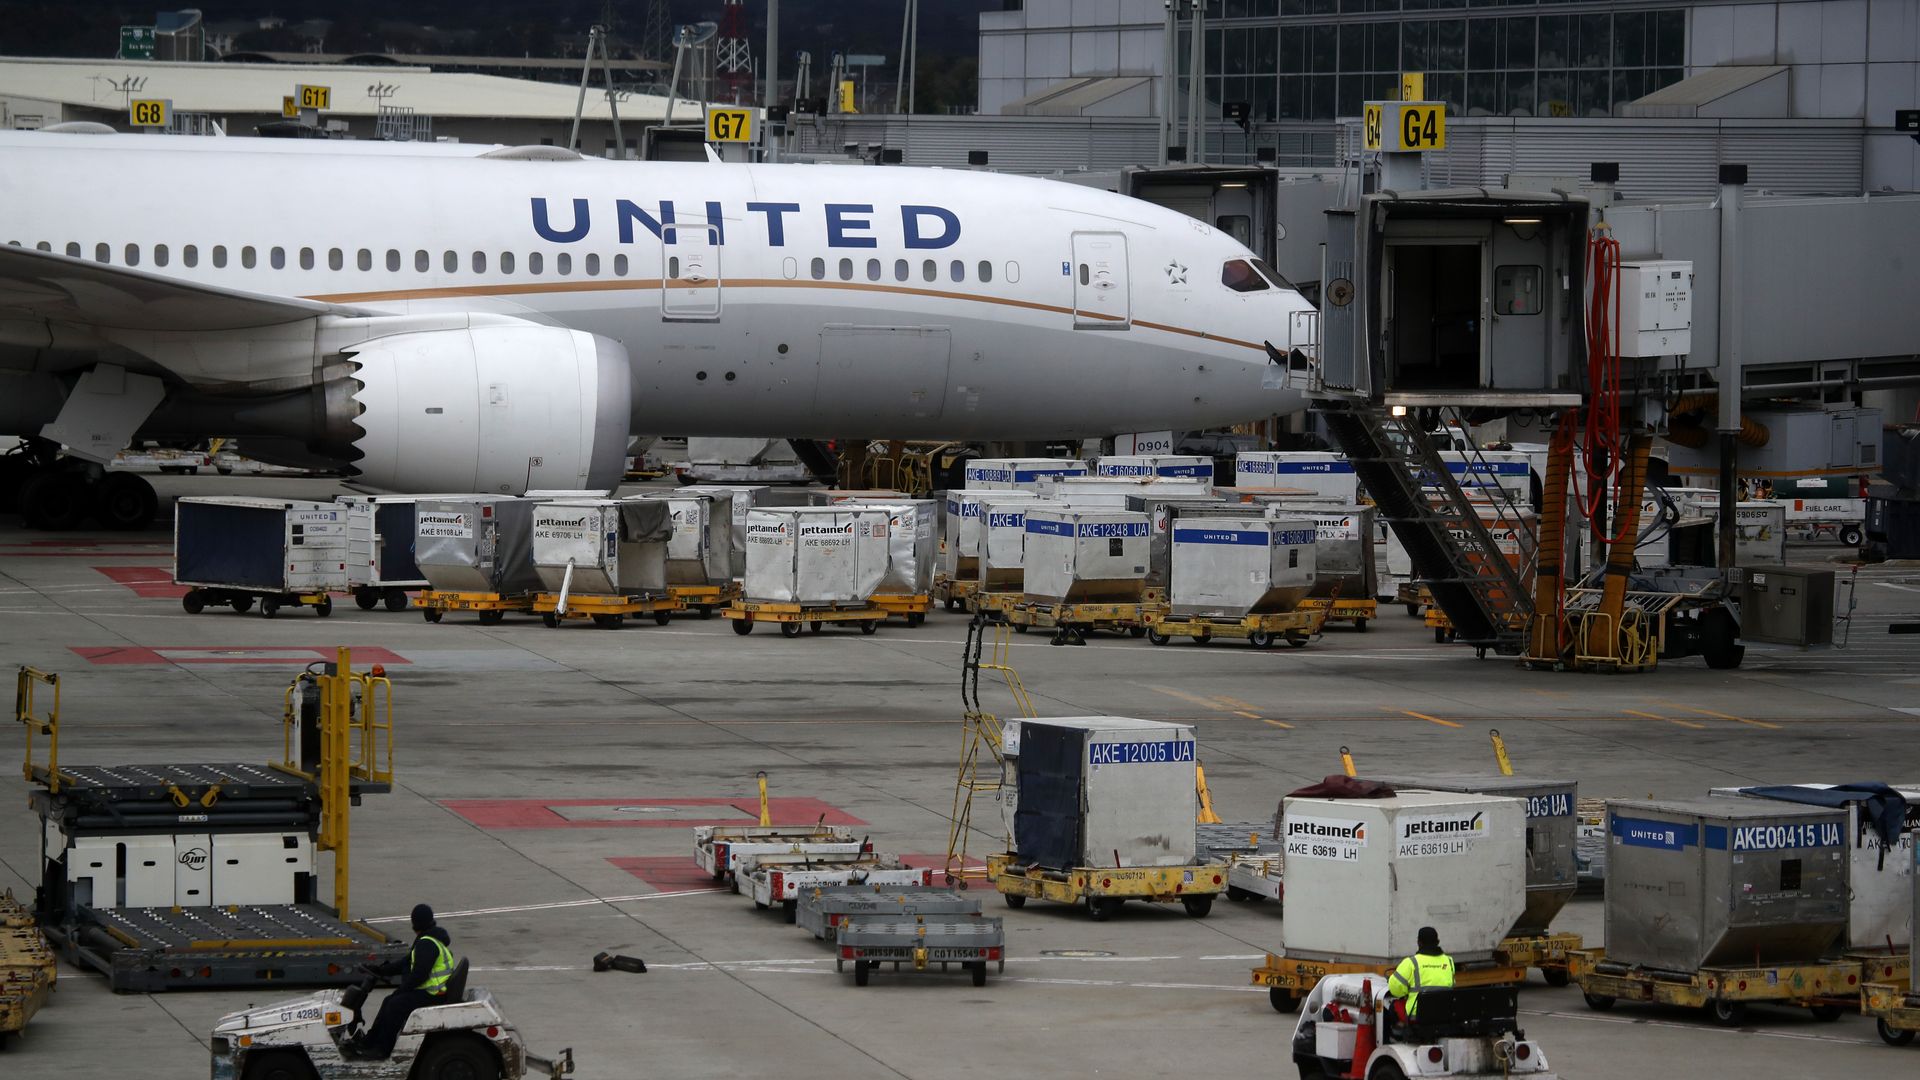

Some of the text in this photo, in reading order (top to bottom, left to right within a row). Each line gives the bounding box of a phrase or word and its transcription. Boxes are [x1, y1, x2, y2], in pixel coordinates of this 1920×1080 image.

[303, 88, 327, 106] G11
[136, 103, 160, 123] G8
[714, 112, 745, 139] G7
[1367, 109, 1381, 146] G4
[1404, 109, 1438, 147] G4
[531, 197, 961, 249] UNITED
[1137, 440, 1169, 451] 0904
[968, 468, 980, 480] AKE
[1100, 465, 1113, 476] AKE
[1139, 466, 1151, 476] UA
[420, 515, 462, 524] jettainer
[536, 517, 585, 527] jettainer
[992, 514, 1012, 527] AKE
[747, 522, 784, 534] jettainer
[801, 522, 852, 536] jettainer
[1134, 523, 1148, 536] UA
[1273, 531, 1286, 544] AKE
[1092, 742, 1191, 763] AKE 12005 UA
[1552, 794, 1568, 816] UA
[1287, 822, 1365, 839] jettainer
[1404, 811, 1483, 838] jettainer
[1631, 830, 1664, 841] UNITED
[1821, 824, 1839, 845] UA
[1288, 842, 1357, 859] AKE 63619 LH
[1400, 841, 1464, 856] AKE 63619 LH
[1265, 974, 1295, 986] dnata
[281, 1008, 319, 1022] CT 4288
